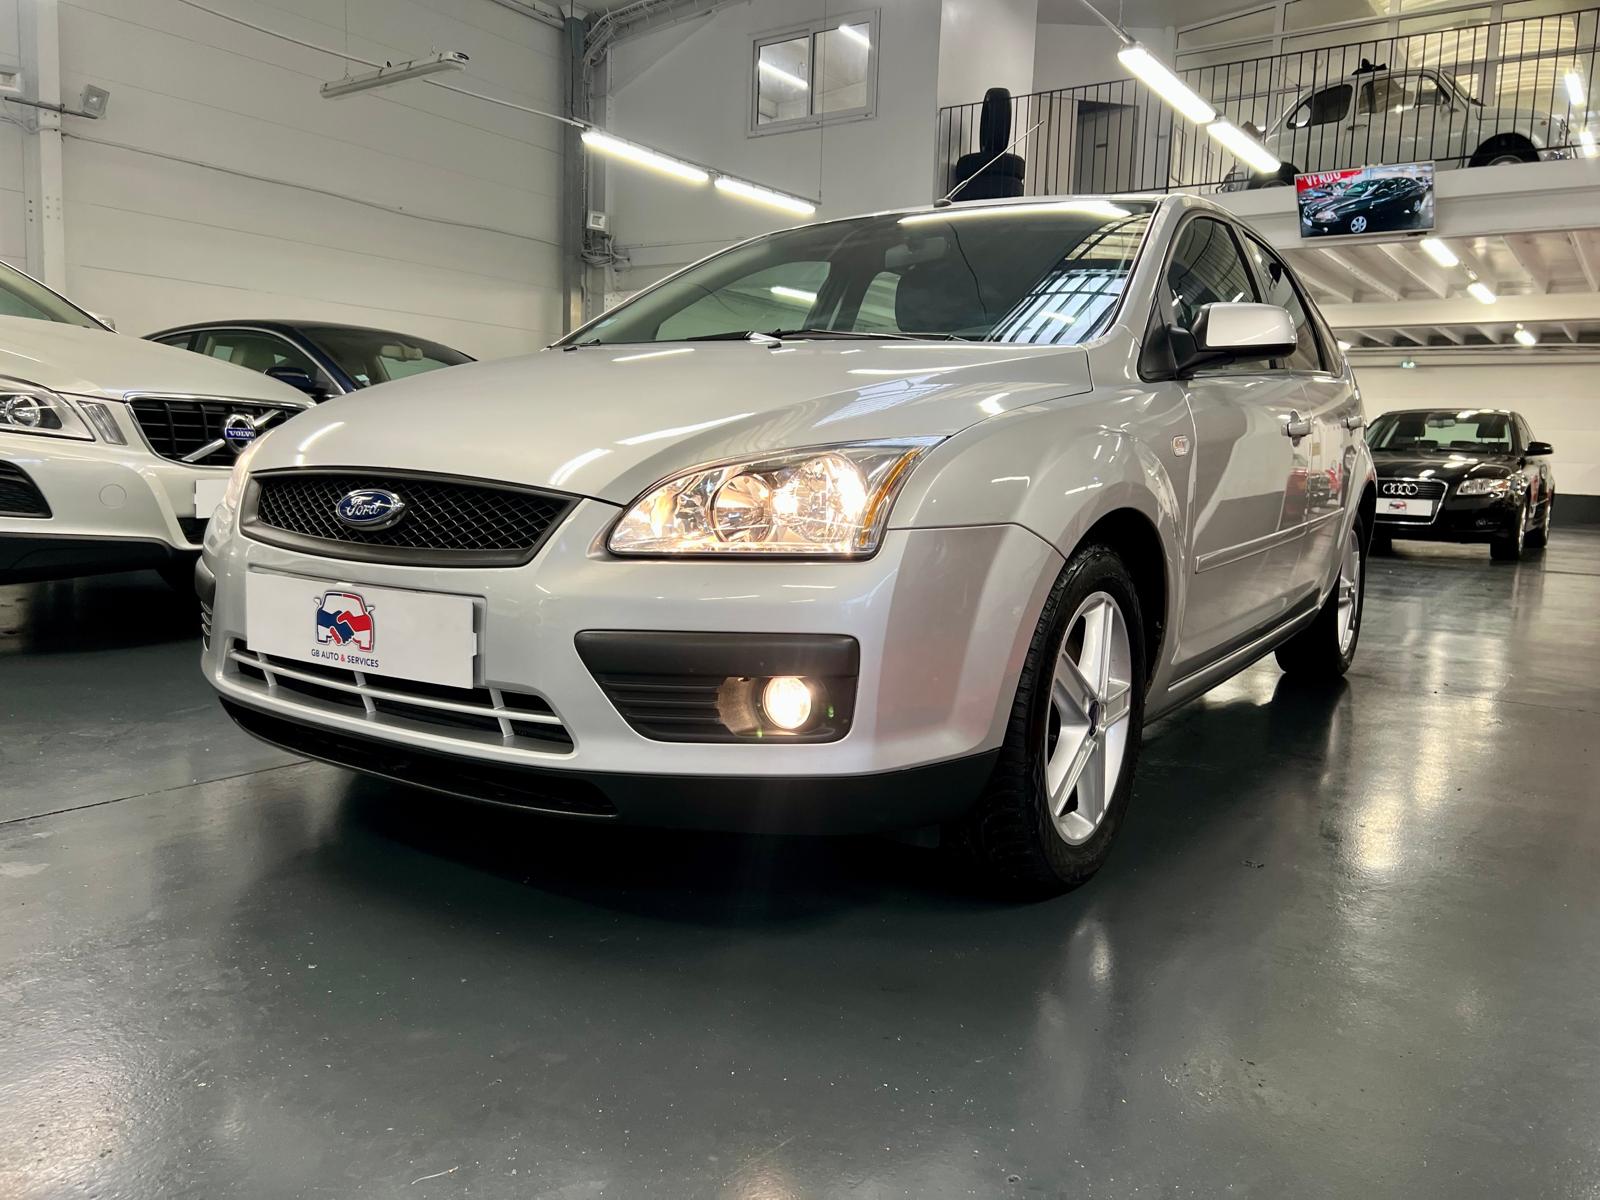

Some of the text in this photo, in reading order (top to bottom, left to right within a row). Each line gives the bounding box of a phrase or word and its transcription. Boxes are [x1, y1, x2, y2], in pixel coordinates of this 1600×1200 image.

[345, 496, 392, 516] Ford
[311, 649, 379, 668] GB AUTO & SERVICES
